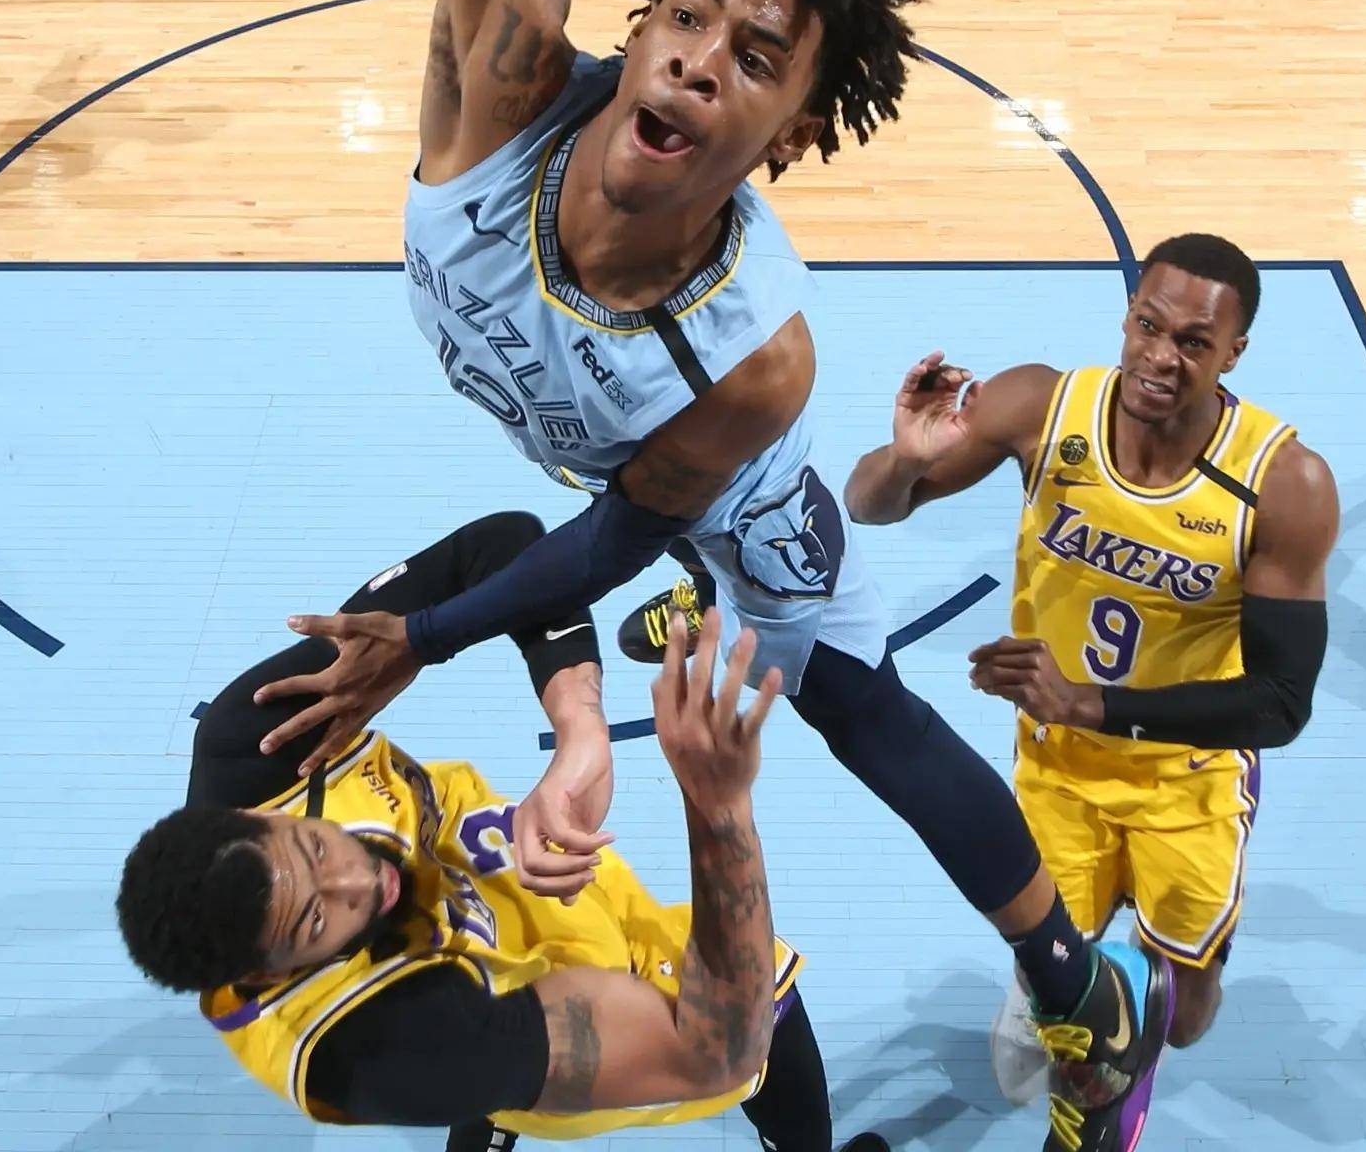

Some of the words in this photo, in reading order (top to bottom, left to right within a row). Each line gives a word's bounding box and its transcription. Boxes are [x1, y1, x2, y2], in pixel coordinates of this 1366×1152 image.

[572, 335, 634, 411] FedEx
[1038, 502, 1222, 603] LAKERS
[1176, 511, 1228, 537] wish
[1082, 594, 1154, 686] 9
[360, 760, 402, 815] wish
